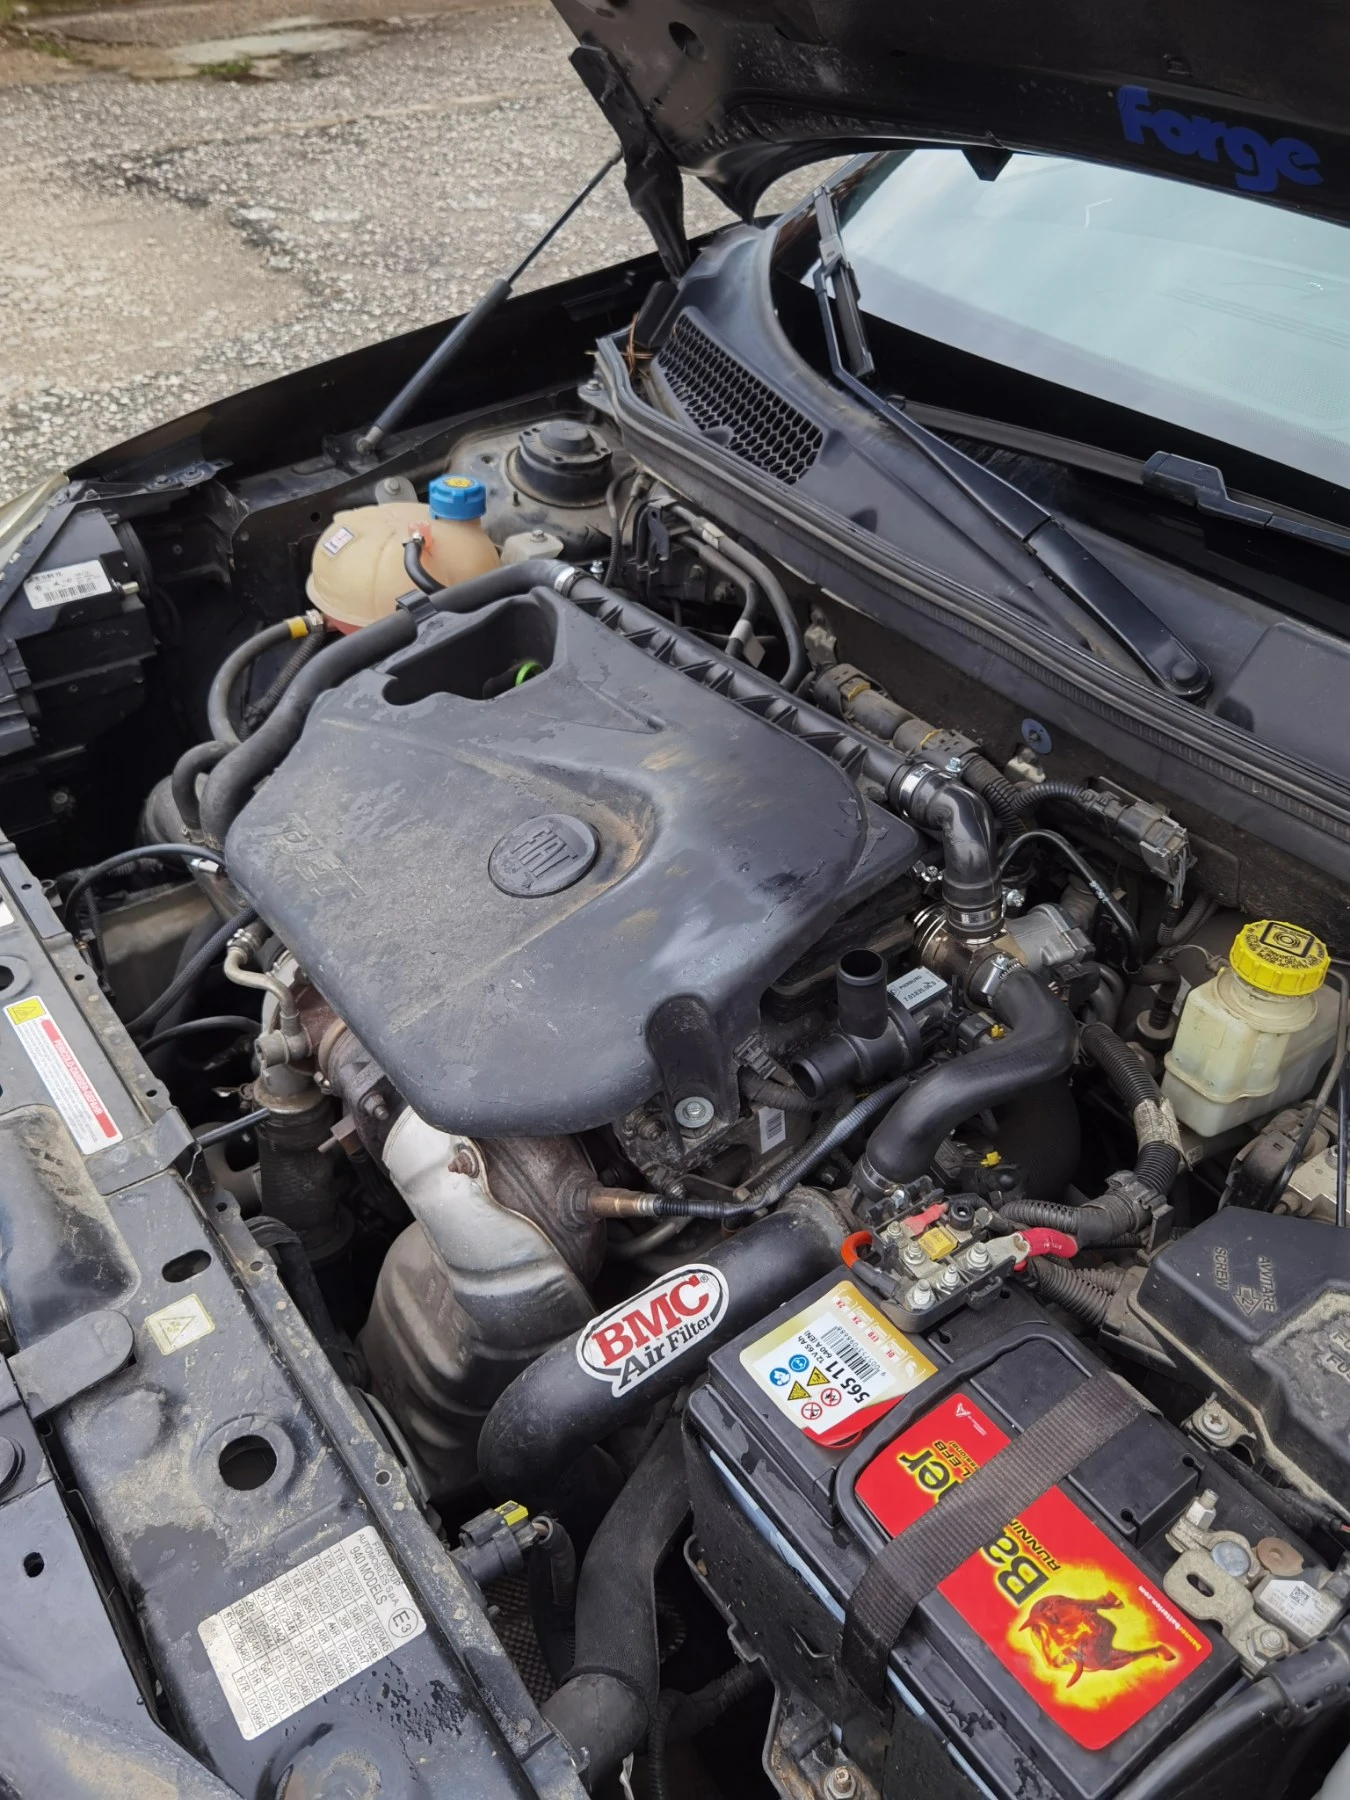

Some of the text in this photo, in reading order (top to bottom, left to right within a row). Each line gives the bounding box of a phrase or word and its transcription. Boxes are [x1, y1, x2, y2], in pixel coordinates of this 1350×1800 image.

[1116, 84, 1324, 192] Forge
[510, 825, 578, 879] FIAT
[1214, 1247, 1229, 1290] SCREW
[1258, 1255, 1277, 1312] AVVITARE
[592, 1275, 709, 1367] BMC
[796, 1335, 806, 1345] Ah
[803, 1328, 818, 1344] (EN)
[619, 1316, 711, 1390] Air Filter
[819, 1345, 832, 1359] 640
[825, 1359, 870, 1405] 565 11
[934, 1441, 962, 1467] EFB
[299, 1564, 315, 1584] 13HR
[322, 1554, 335, 1570] 12R
[332, 1548, 345, 1563] 11R
[359, 1600, 373, 1617] 28R
[348, 1545, 387, 1605] 940 MODELS
[357, 1532, 389, 1585] AUTOMOBILES
[371, 1541, 400, 1587] FIAT GROUP
[266, 1584, 282, 1604] 17RA
[293, 1641, 308, 1658] 51R
[278, 1579, 292, 1595] 16R
[304, 1634, 319, 1651] 51R
[289, 1573, 303, 1588] 14R
[315, 1627, 330, 1644] 48R
[310, 1558, 326, 1578] 13HR
[337, 1614, 352, 1631] 39R
[1137, 1585, 1202, 1651] bannerbatterien.com
[222, 1611, 237, 1628] 51R
[247, 1668, 262, 1686] 51R
[255, 1590, 270, 1608] 21R
[281, 1648, 297, 1665] 51R
[235, 1675, 251, 1693] 67R
[258, 1661, 274, 1679] 64R
[270, 1654, 286, 1672] 51R
